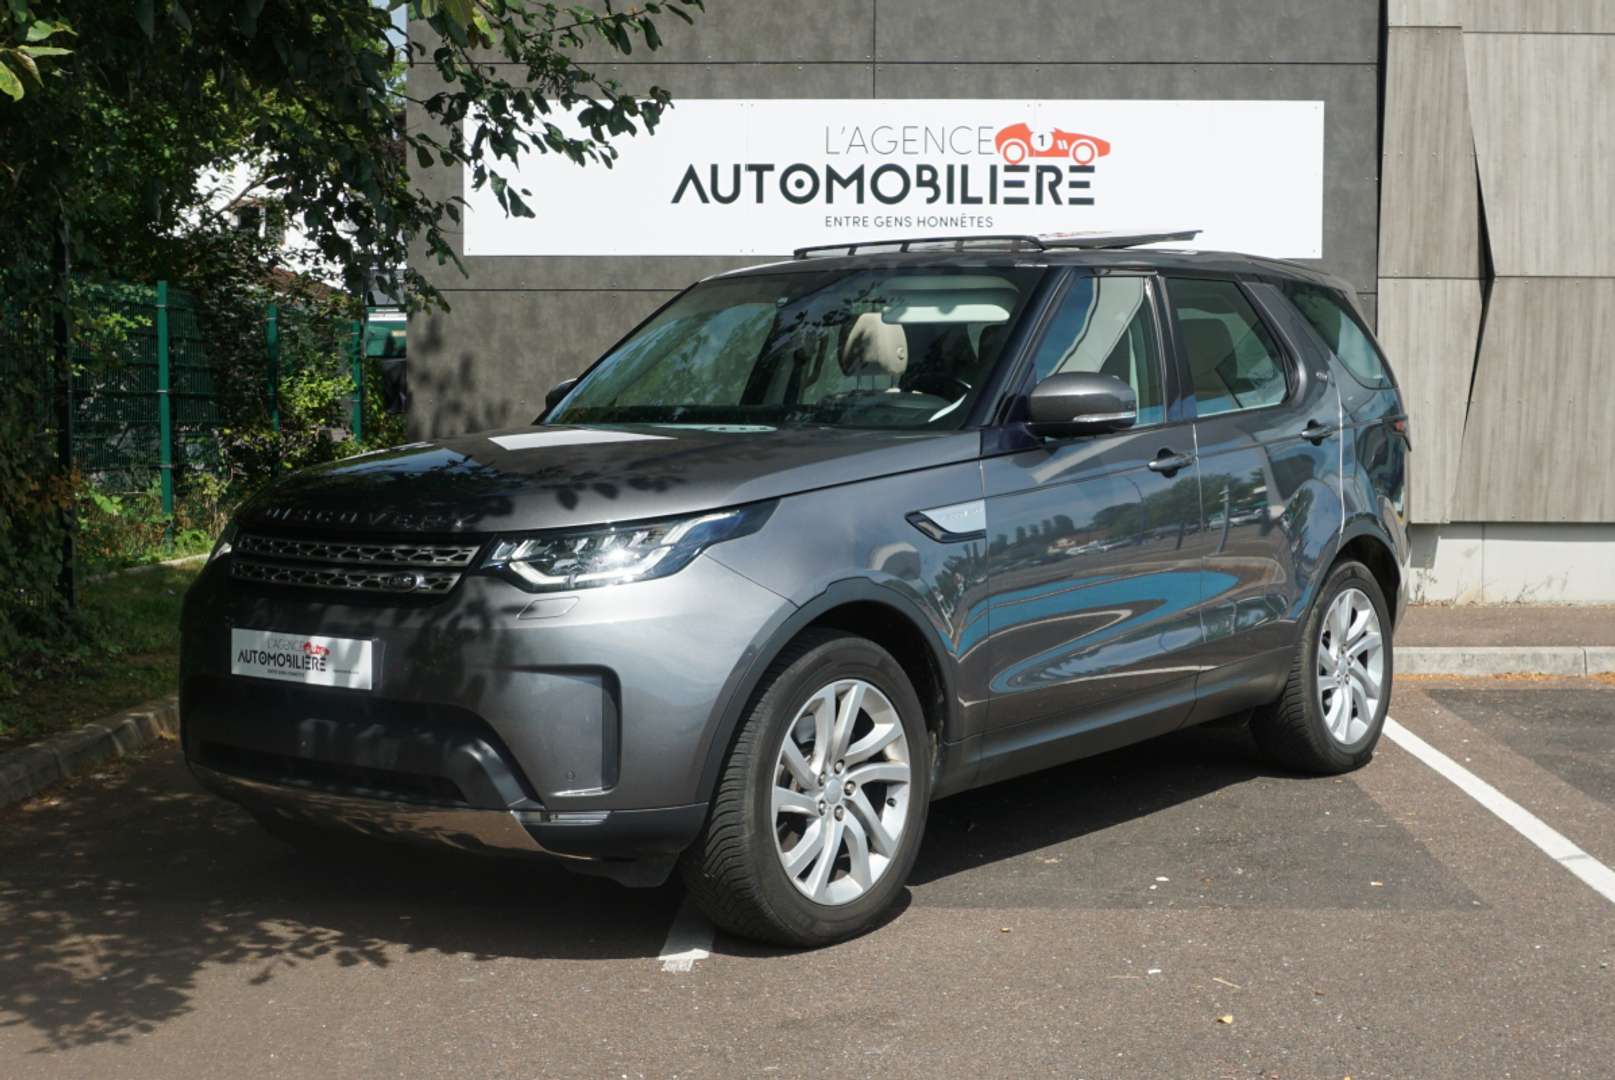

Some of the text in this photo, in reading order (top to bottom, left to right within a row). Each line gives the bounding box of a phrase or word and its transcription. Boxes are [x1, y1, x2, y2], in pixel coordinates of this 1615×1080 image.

[824, 125, 994, 156] L'AGENCE
[1038, 134, 1045, 147] 1
[824, 212, 993, 228] ENTRE GENS HONNÊTES
